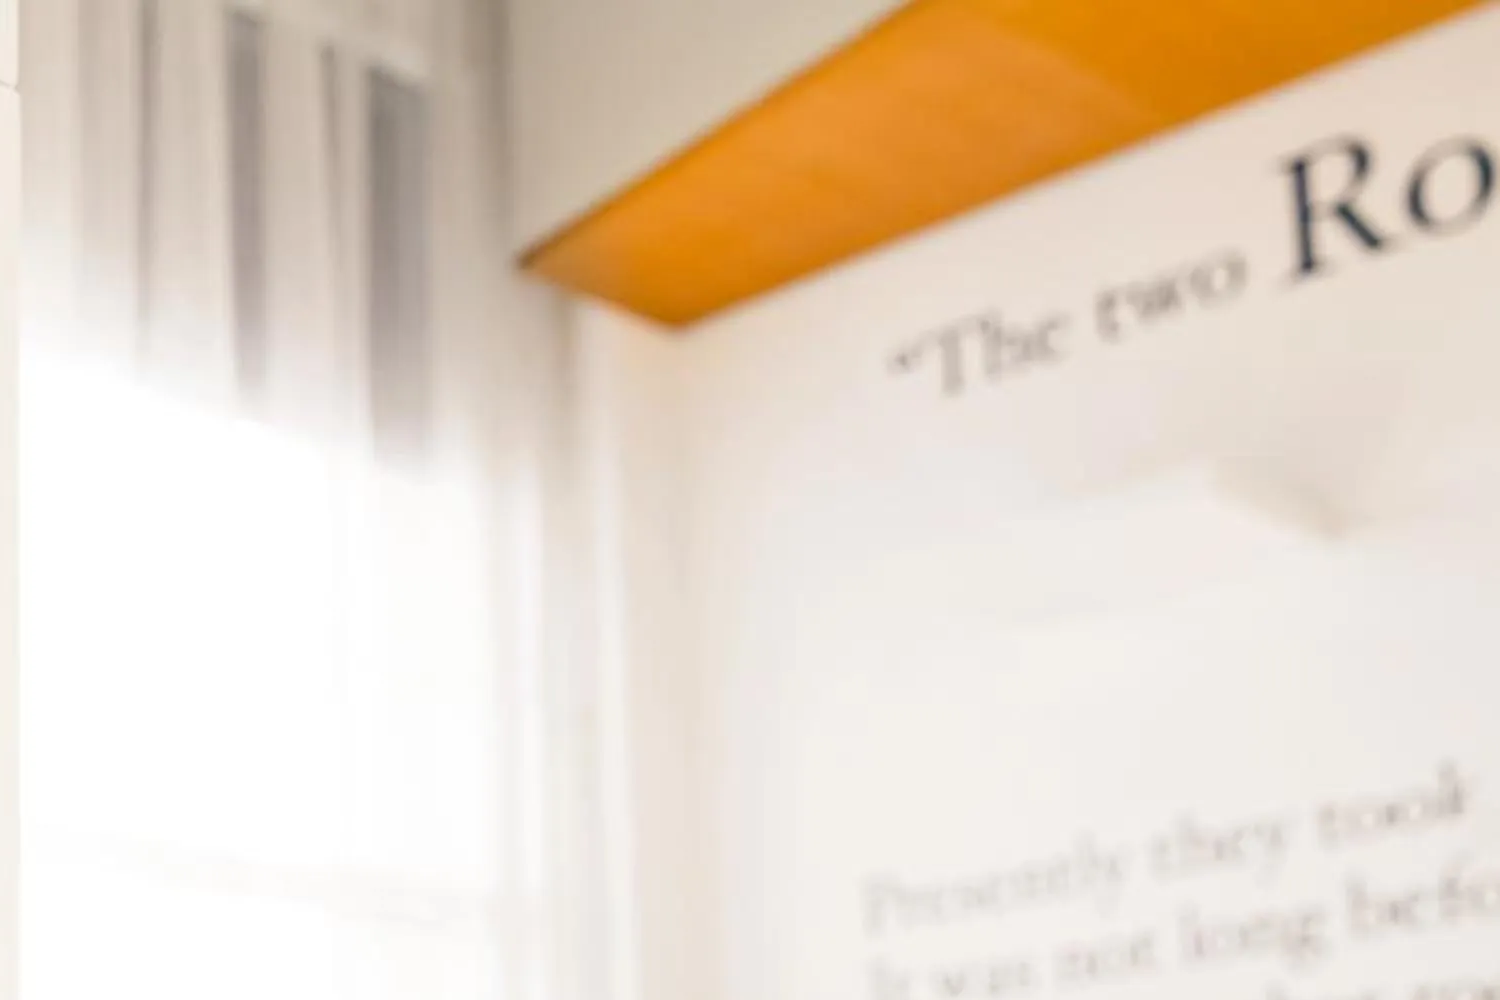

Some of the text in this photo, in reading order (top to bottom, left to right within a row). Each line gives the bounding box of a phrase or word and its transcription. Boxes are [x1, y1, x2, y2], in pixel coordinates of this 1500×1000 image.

[1092, 247, 1252, 342] two
[860, 755, 1480, 938] Presently they took
[1053, 926, 1160, 993] not
[1176, 902, 1335, 980] long
